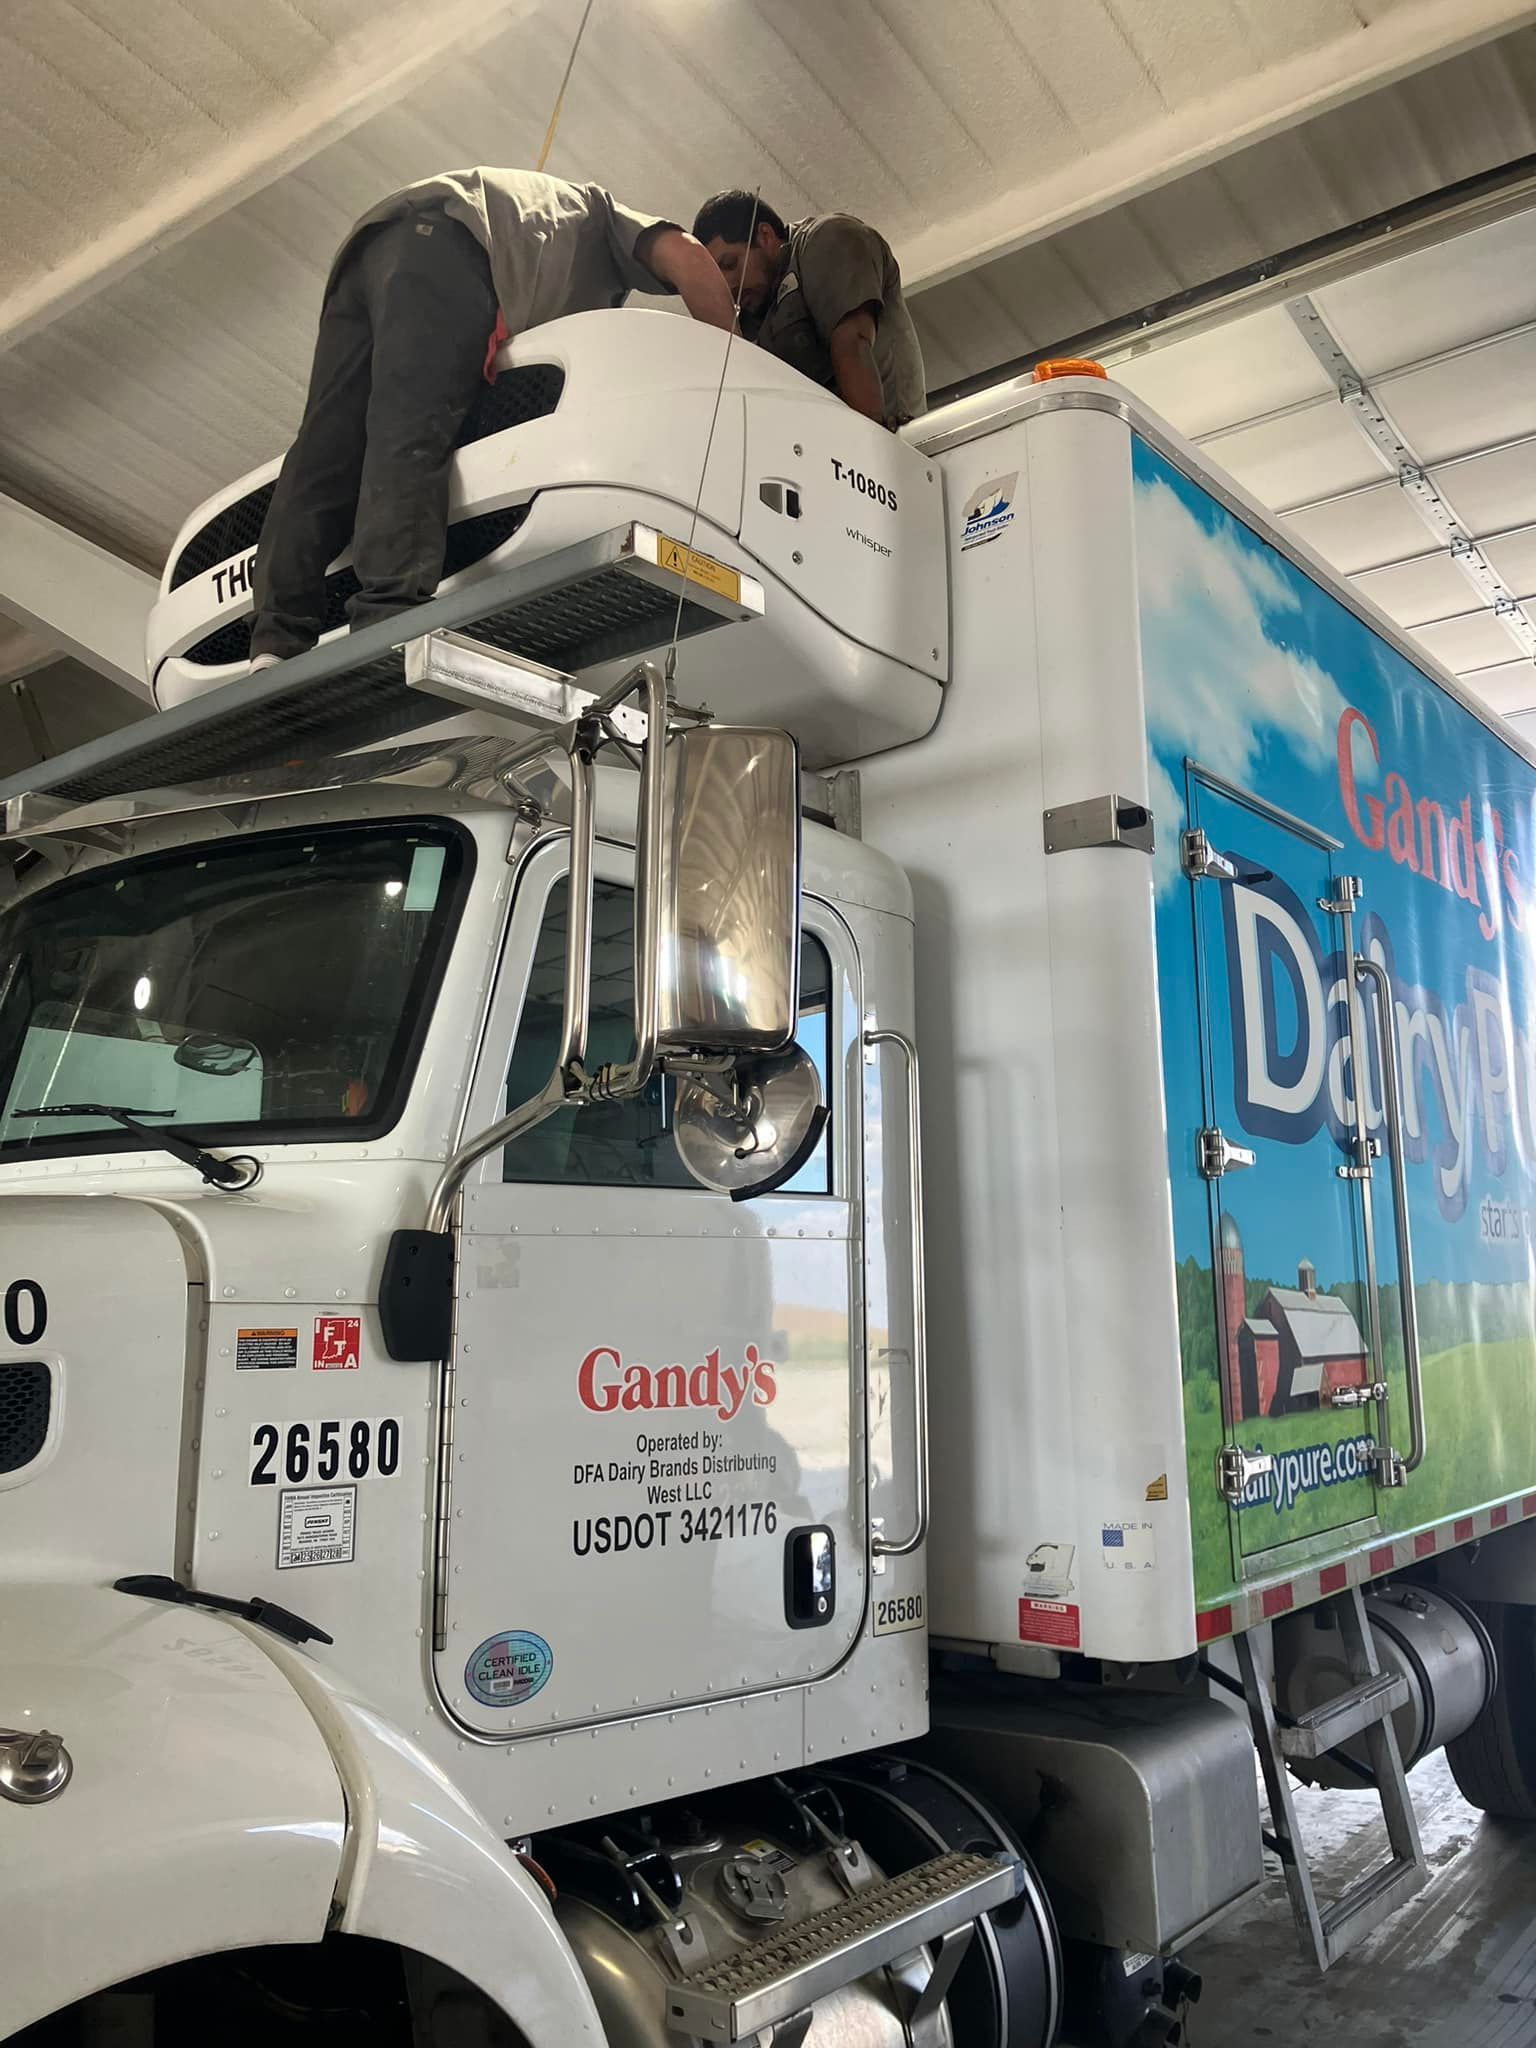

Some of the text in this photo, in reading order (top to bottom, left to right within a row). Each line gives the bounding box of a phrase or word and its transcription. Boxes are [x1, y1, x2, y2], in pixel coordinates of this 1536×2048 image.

[830, 457, 898, 511] T-1080S
[961, 512, 1016, 537] Johnson
[845, 526, 893, 558] whisper
[1337, 706, 1527, 942] Gandy's
[347, 1319, 359, 1328] 24
[577, 1344, 778, 1422] Gandy's
[250, 1418, 400, 1486] 26580
[636, 1431, 723, 1457] Operated by:
[574, 1452, 778, 1485] DFA Dairy Brands Distributing
[647, 1480, 713, 1505] West LLC
[573, 1501, 778, 1557] USDOT 3421176
[1103, 1522, 1138, 1530] MADE
[877, 1594, 923, 1626] 26580
[478, 1663, 541, 1681] CLEAN IDLE
[484, 1652, 537, 1668] CERTIFIED
